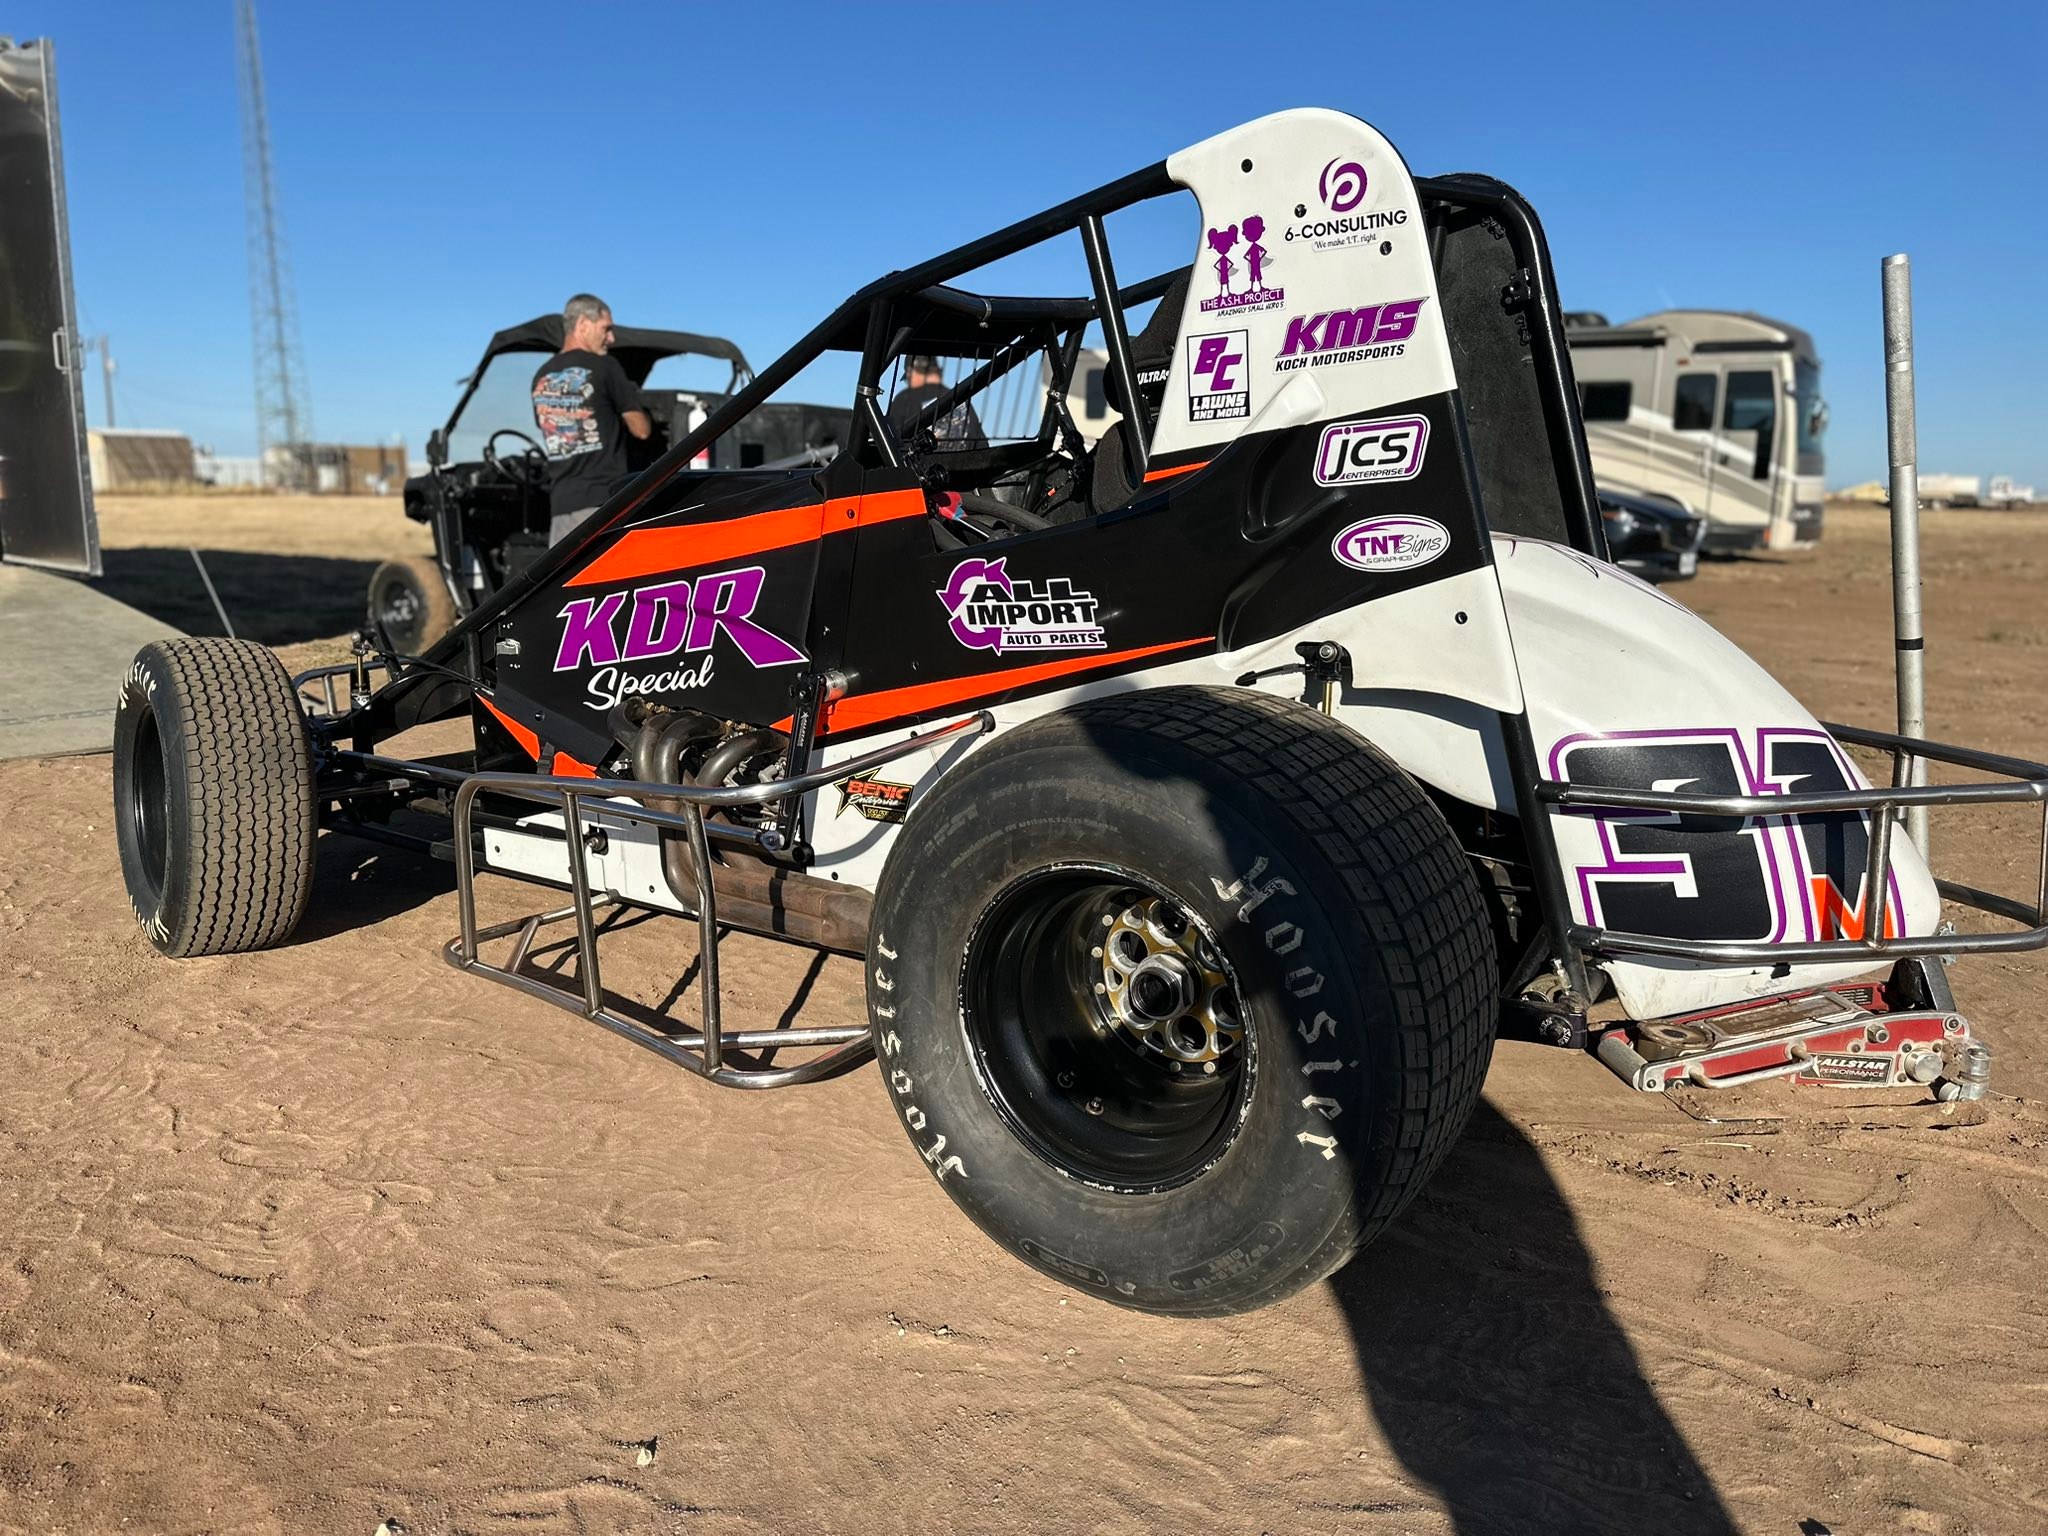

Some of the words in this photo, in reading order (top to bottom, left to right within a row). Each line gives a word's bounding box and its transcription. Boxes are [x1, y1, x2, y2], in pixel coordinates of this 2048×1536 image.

[1284, 209, 1408, 242] 6-CONSULTING
[1360, 233, 1377, 245] right
[1201, 300, 1219, 311] THE
[1244, 289, 1282, 304] PROJECT
[1247, 303, 1264, 313] SMALL
[1275, 297, 1430, 358] KMS
[1275, 357, 1308, 372] KOCH
[1311, 343, 1406, 367] MOTORSPORTS
[1192, 392, 1247, 412] LAWNS
[1193, 409, 1215, 421] AND
[1216, 406, 1247, 419] MORE
[1345, 467, 1404, 480] ENTERPRISE
[1354, 534, 1404, 557] TNT
[1395, 534, 1442, 558] Signs
[969, 580, 1091, 603] ALL
[553, 566, 810, 673] KDR
[966, 600, 1097, 626] IMPORT
[1006, 633, 1042, 645] AUTO
[1050, 632, 1099, 645] PARTS
[583, 654, 715, 711] Special
[1819, 1067, 1885, 1078] PERFORMANCE
[1820, 1058, 1888, 1071] ALLSTAR
